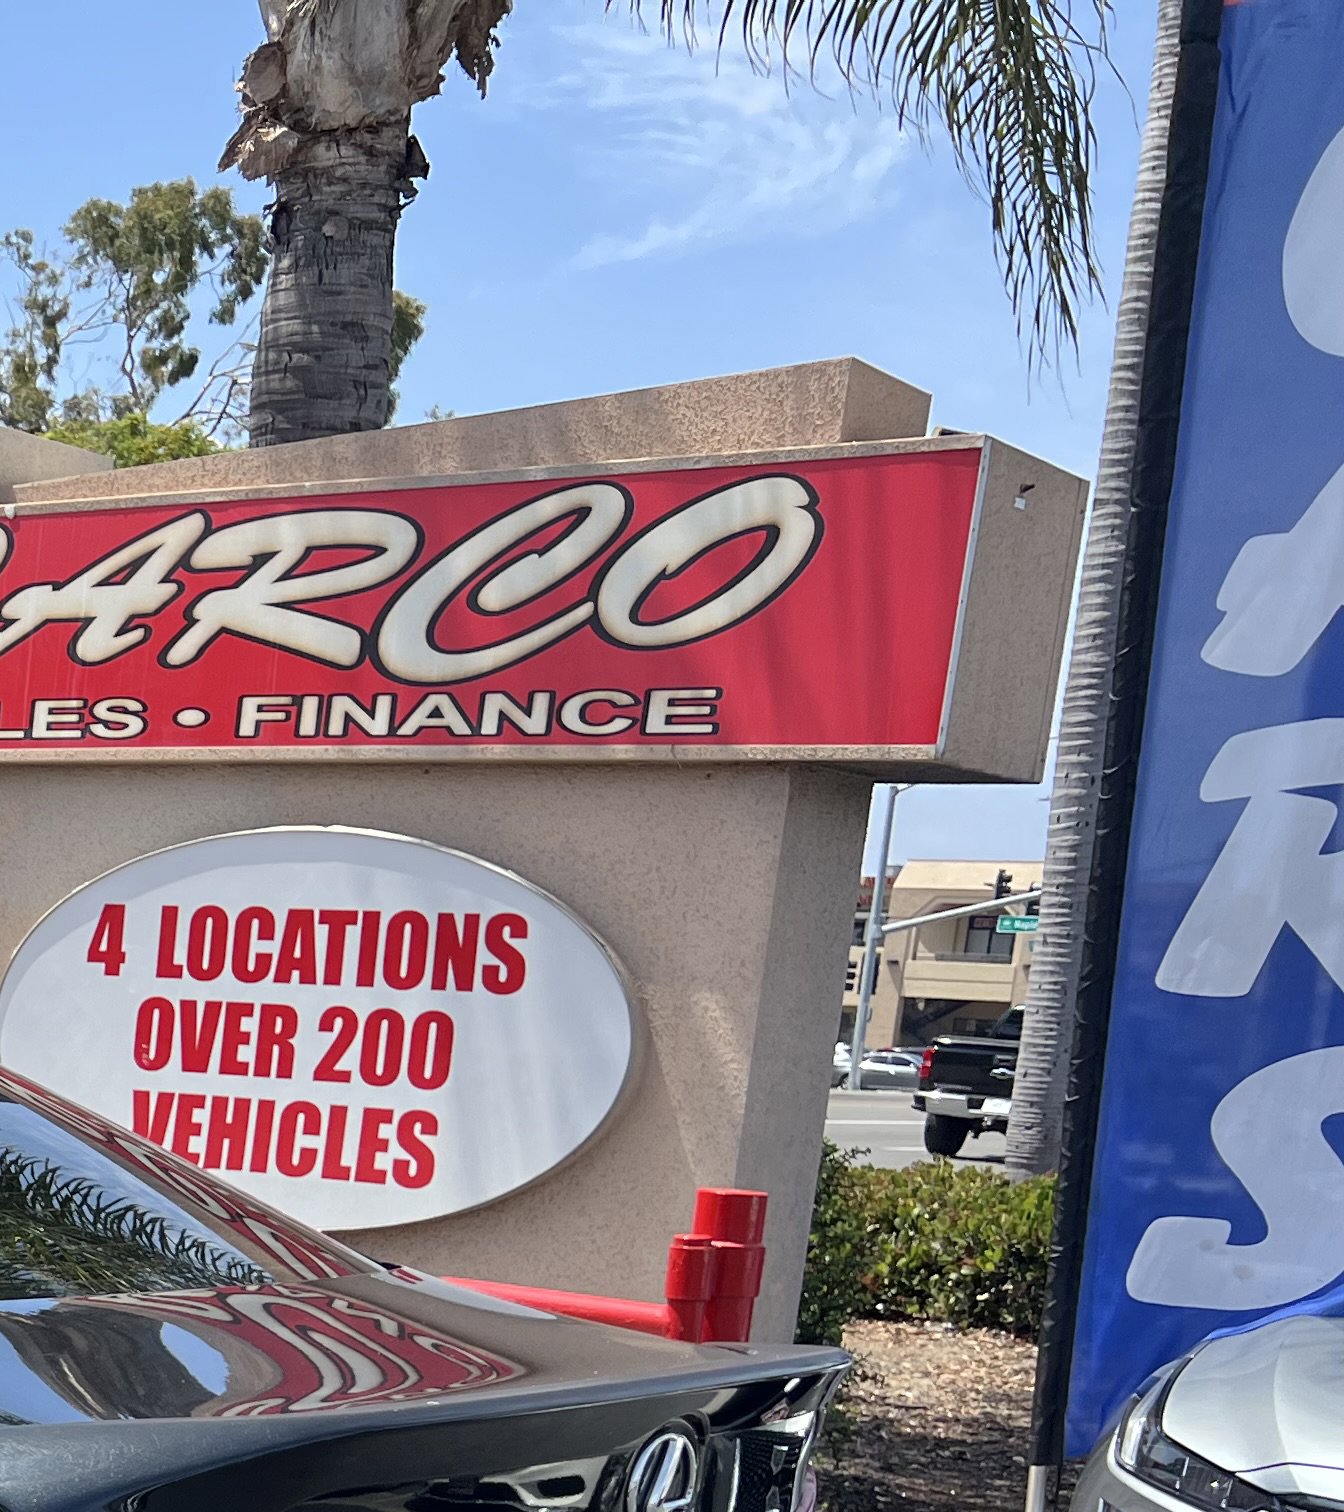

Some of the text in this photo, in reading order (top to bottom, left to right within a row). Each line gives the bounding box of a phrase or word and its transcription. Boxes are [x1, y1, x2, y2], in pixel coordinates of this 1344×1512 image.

[234, 686, 722, 740] FINANCE
[87, 903, 530, 996] 4 LOCATIONS
[133, 996, 455, 1090] OVER 200
[131, 1089, 439, 1190] VEHICLES
